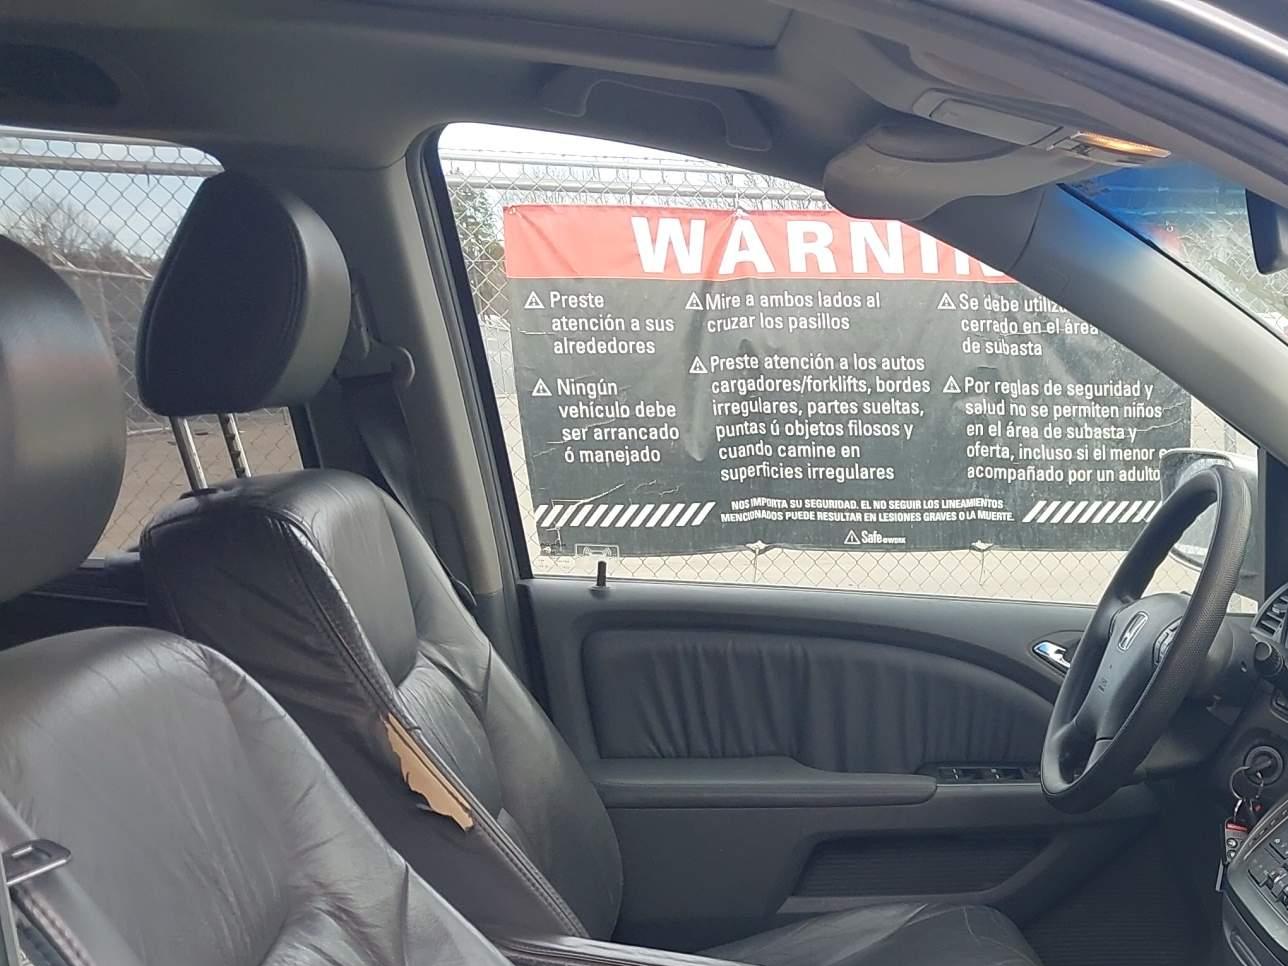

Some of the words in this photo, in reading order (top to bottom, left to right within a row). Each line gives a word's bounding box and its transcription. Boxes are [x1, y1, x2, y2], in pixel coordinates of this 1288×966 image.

[550, 291, 604, 309] Preste
[705, 293, 741, 311] Mire
[745, 294, 755, 306] a
[759, 291, 813, 308] ambos
[818, 291, 861, 308] lados
[866, 292, 880, 308] al
[959, 294, 978, 310] Se
[984, 294, 1019, 312] debe
[551, 313, 625, 333] atención
[630, 318, 641, 332] a
[645, 317, 675, 332] sus
[707, 314, 755, 333] cruzar
[760, 313, 783, 329] los
[788, 312, 850, 333] pasillos
[961, 318, 1018, 335] cerrado
[1023, 321, 1041, 334] en
[1046, 318, 1060, 334] el
[1065, 319, 1099, 335] área
[553, 336, 656, 354] alrededores
[962, 338, 981, 354] de
[985, 340, 1042, 356] subasta
[710, 354, 759, 372] Preste
[764, 353, 834, 370] atención
[839, 358, 849, 370] a
[853, 354, 877, 370] los
[881, 356, 925, 371] autos
[557, 377, 617, 398] Ningún
[711, 375, 872, 395] cargadores/forklifts,
[876, 376, 930, 393] bordes
[964, 377, 990, 394] Por
[994, 379, 1039, 398] reglas
[1043, 379, 1062, 396] de
[1066, 379, 1141, 399] seguridad
[1144, 383, 1154, 400] y
[559, 399, 631, 418] vehículo
[635, 403, 676, 417] debe
[712, 397, 803, 416] irregulares,
[807, 400, 858, 418] partes
[862, 398, 924, 417] sueltas,
[965, 398, 1005, 416] salud
[1009, 403, 1026, 417] no
[1030, 404, 1049, 417] se
[1053, 402, 1119, 421] permiten
[1123, 402, 1162, 418] niños
[561, 428, 590, 442] ser
[593, 423, 680, 441] arrancado
[715, 422, 766, 441] puntas
[770, 421, 780, 436] ú
[785, 420, 844, 440] objetos
[848, 420, 900, 437] filosos
[904, 423, 913, 440] y
[967, 424, 984, 437] en
[988, 421, 1001, 437] el
[1006, 422, 1039, 439] área
[1043, 421, 1062, 439] de
[1066, 422, 1125, 440] subasta
[1128, 427, 1137, 443] y
[564, 447, 574, 463] ó
[580, 446, 661, 466] manejado
[718, 441, 773, 460] cuando
[777, 441, 836, 458] camine
[841, 446, 861, 458] en
[967, 443, 1014, 461] oferta,
[1019, 444, 1073, 461] incluso
[1076, 445, 1089, 460] si
[1093, 444, 1106, 460] el
[1110, 448, 1155, 461] menor
[720, 462, 804, 483] superficies
[807, 463, 895, 483] irregulares
[967, 465, 1064, 484] acompañado
[1068, 470, 1092, 485] por
[1097, 469, 1115, 482] un
[1119, 465, 1160, 482] adulto
[731, 499, 750, 510] NOS
[751, 497, 788, 508] IMPORTA
[790, 499, 801, 508] SU
[804, 499, 859, 509] SEGURIDAD.
[861, 500, 871, 509] EL
[873, 500, 886, 510] NO
[889, 499, 921, 509] SEGUIR
[923, 499, 939, 509] LOS
[942, 497, 1003, 509] LINEAMIENTOS
[721, 511, 783, 522] MENCIONADOS
[786, 511, 815, 521] PUEDE
[817, 511, 862, 522] RESULTAR
[864, 512, 877, 522] EN
[879, 512, 921, 522] LESIONES
[923, 512, 956, 521] GRAVES
[967, 511, 976, 520] LA
